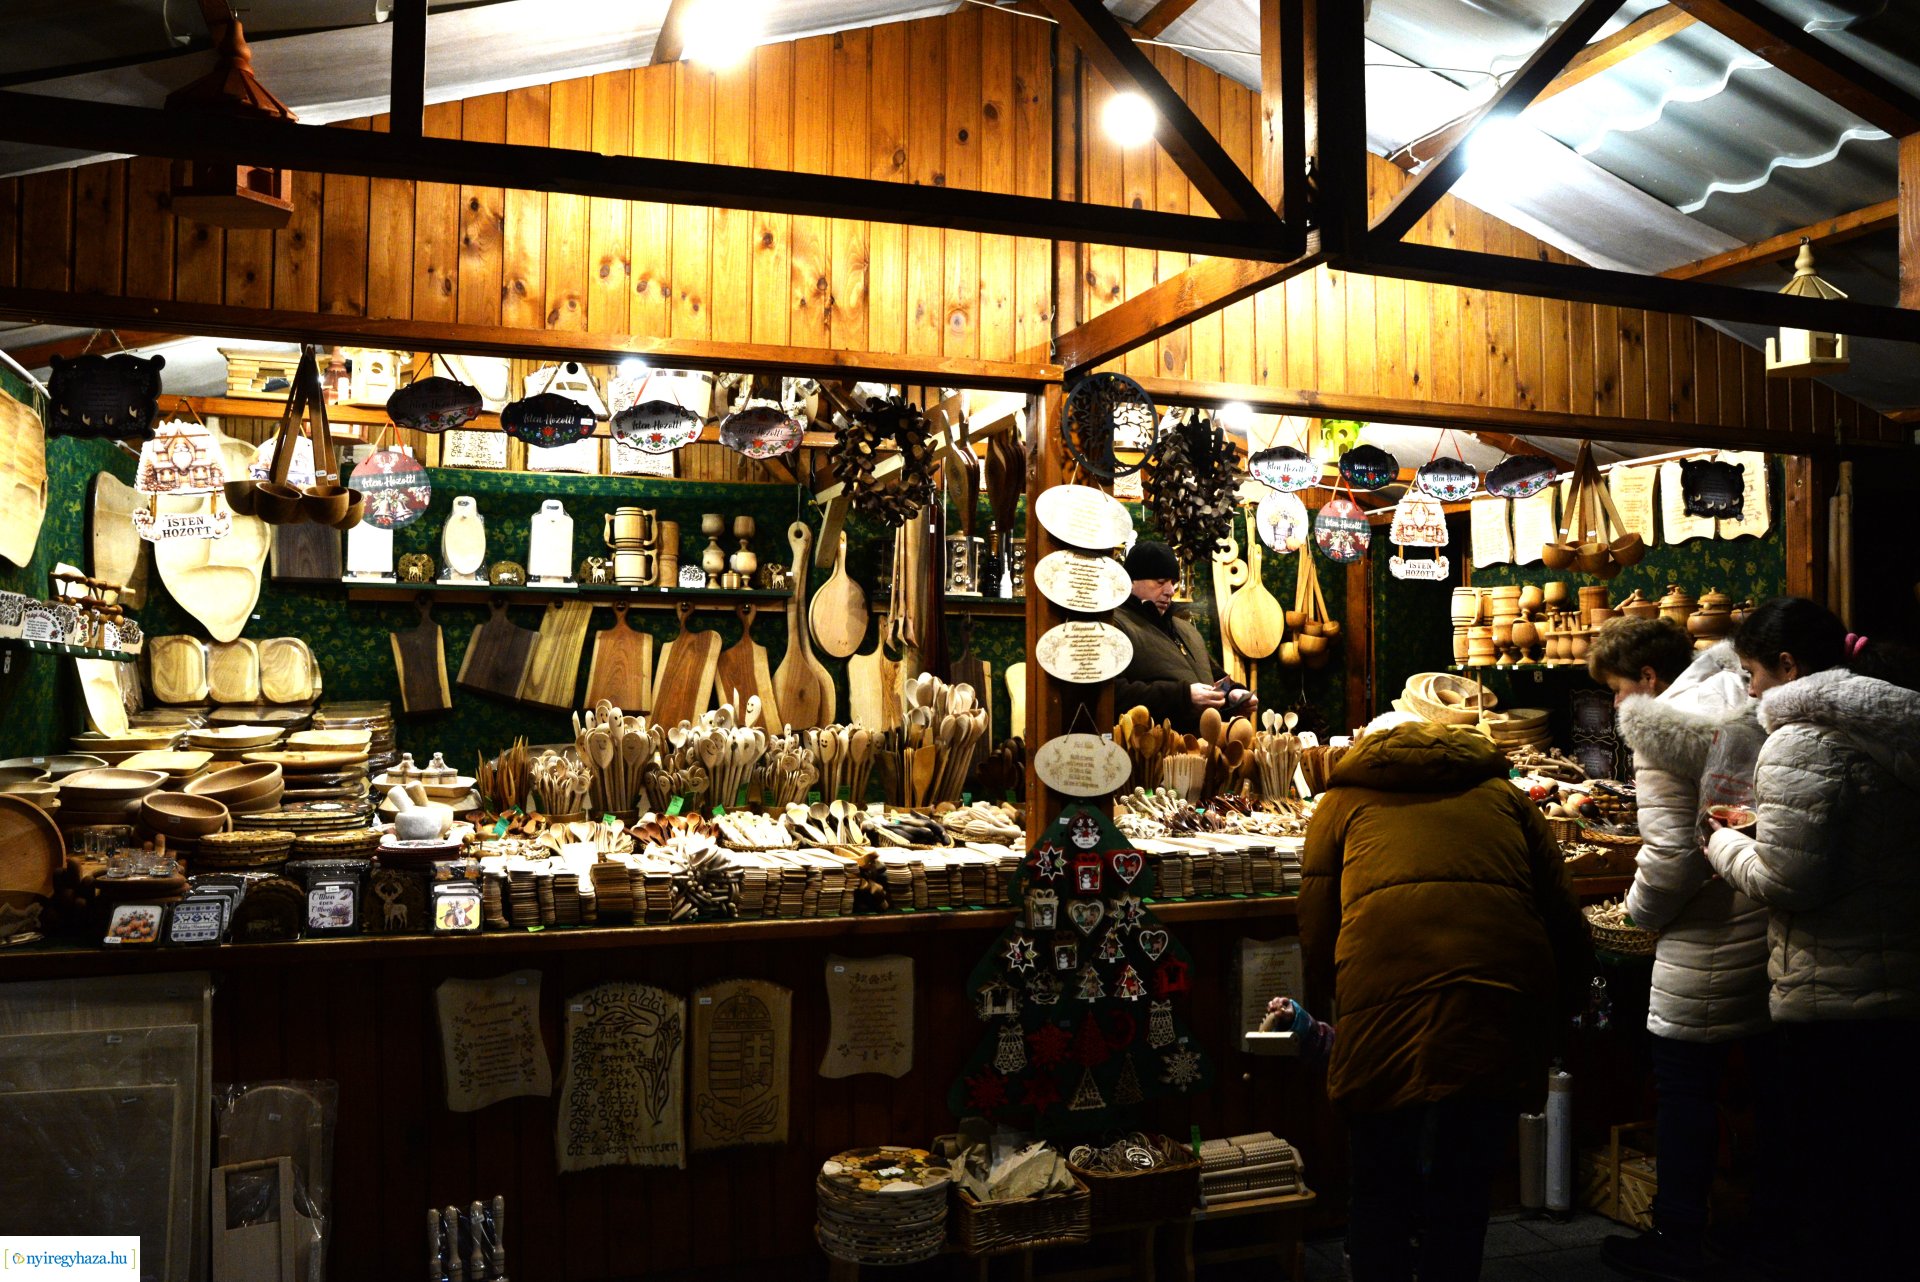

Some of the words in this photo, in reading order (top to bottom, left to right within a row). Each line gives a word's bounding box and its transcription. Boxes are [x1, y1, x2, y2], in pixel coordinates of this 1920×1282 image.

[523, 413, 543, 424] Isten
[543, 413, 575, 425] Hozott!
[632, 420, 651, 430] Isten
[651, 420, 682, 431] Hozott!
[361, 477, 383, 489] Isten
[384, 474, 416, 488] Hozott!
[167, 516, 204, 527] ISTEN
[161, 526, 211, 538] HOZOTT
[1409, 561, 1432, 570] ISTEN
[1405, 569, 1436, 578] HOZOTT
